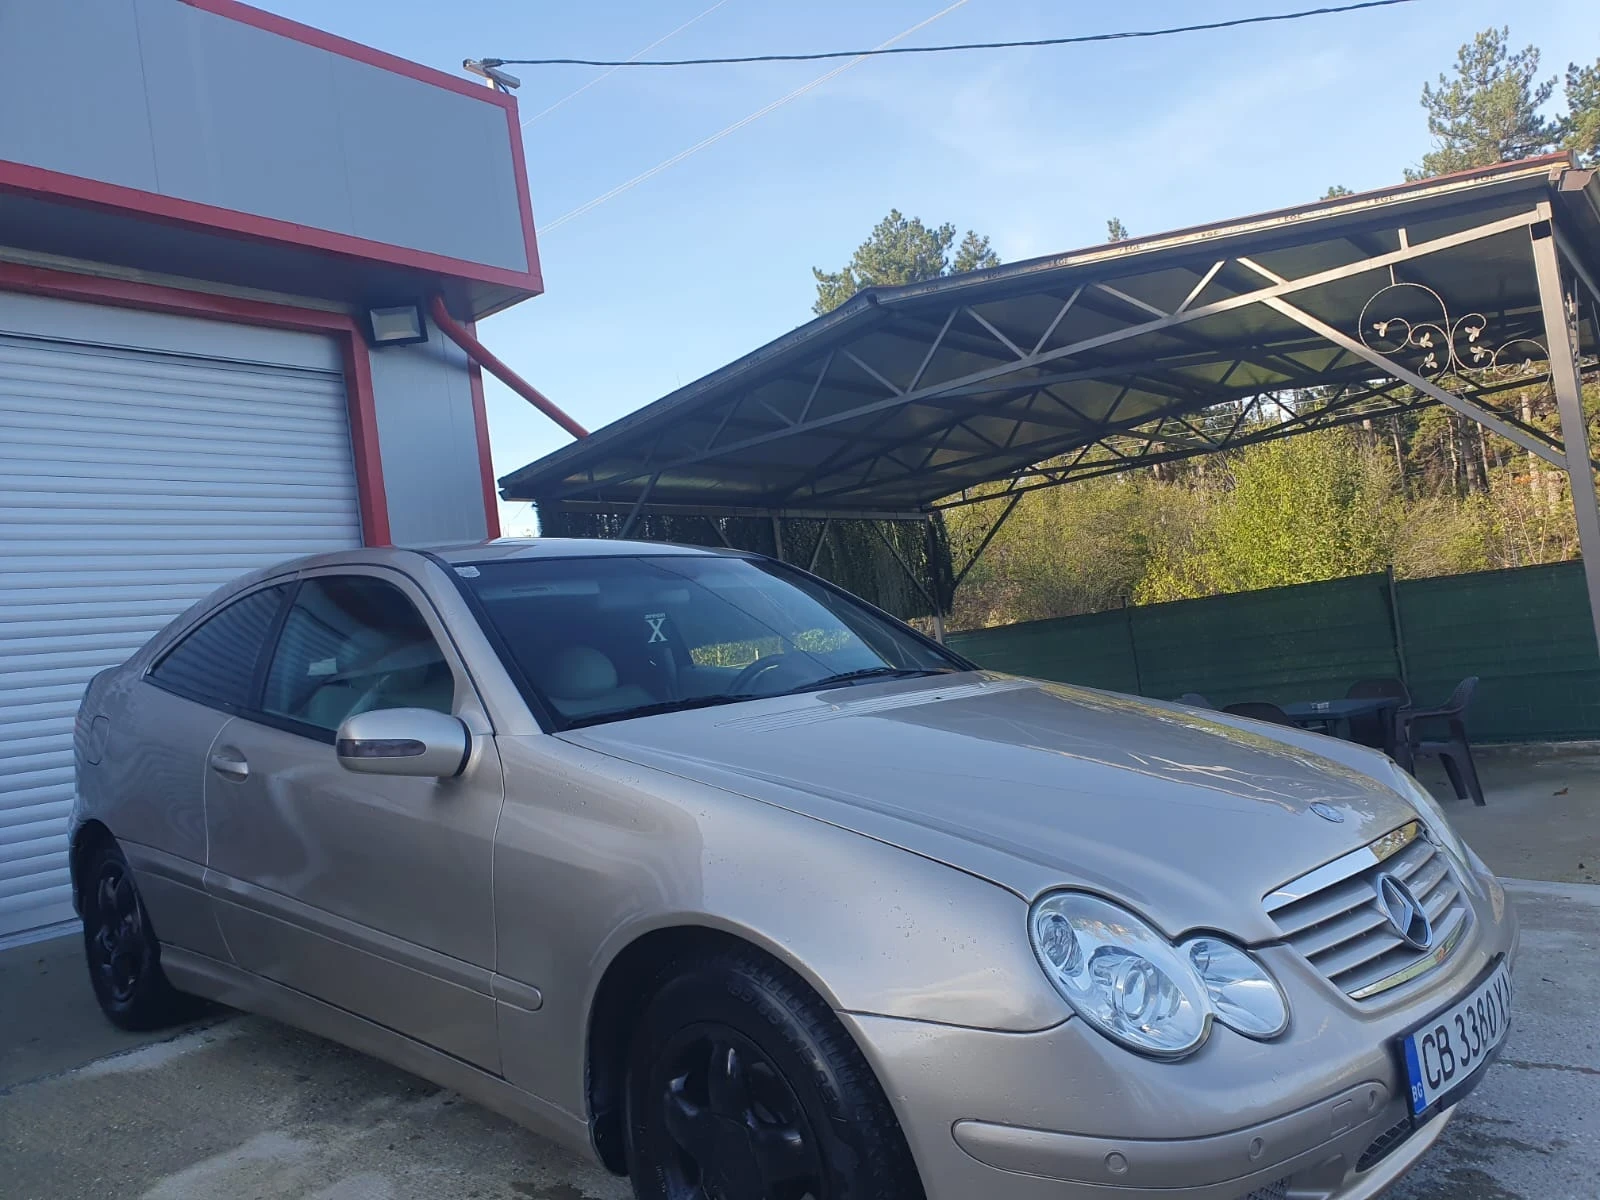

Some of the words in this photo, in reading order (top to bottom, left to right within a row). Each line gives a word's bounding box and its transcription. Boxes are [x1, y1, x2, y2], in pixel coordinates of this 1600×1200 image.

[1421, 1025, 1456, 1090] CB
[1455, 990, 1497, 1067] 3380
[1411, 1082, 1423, 1101] BG
